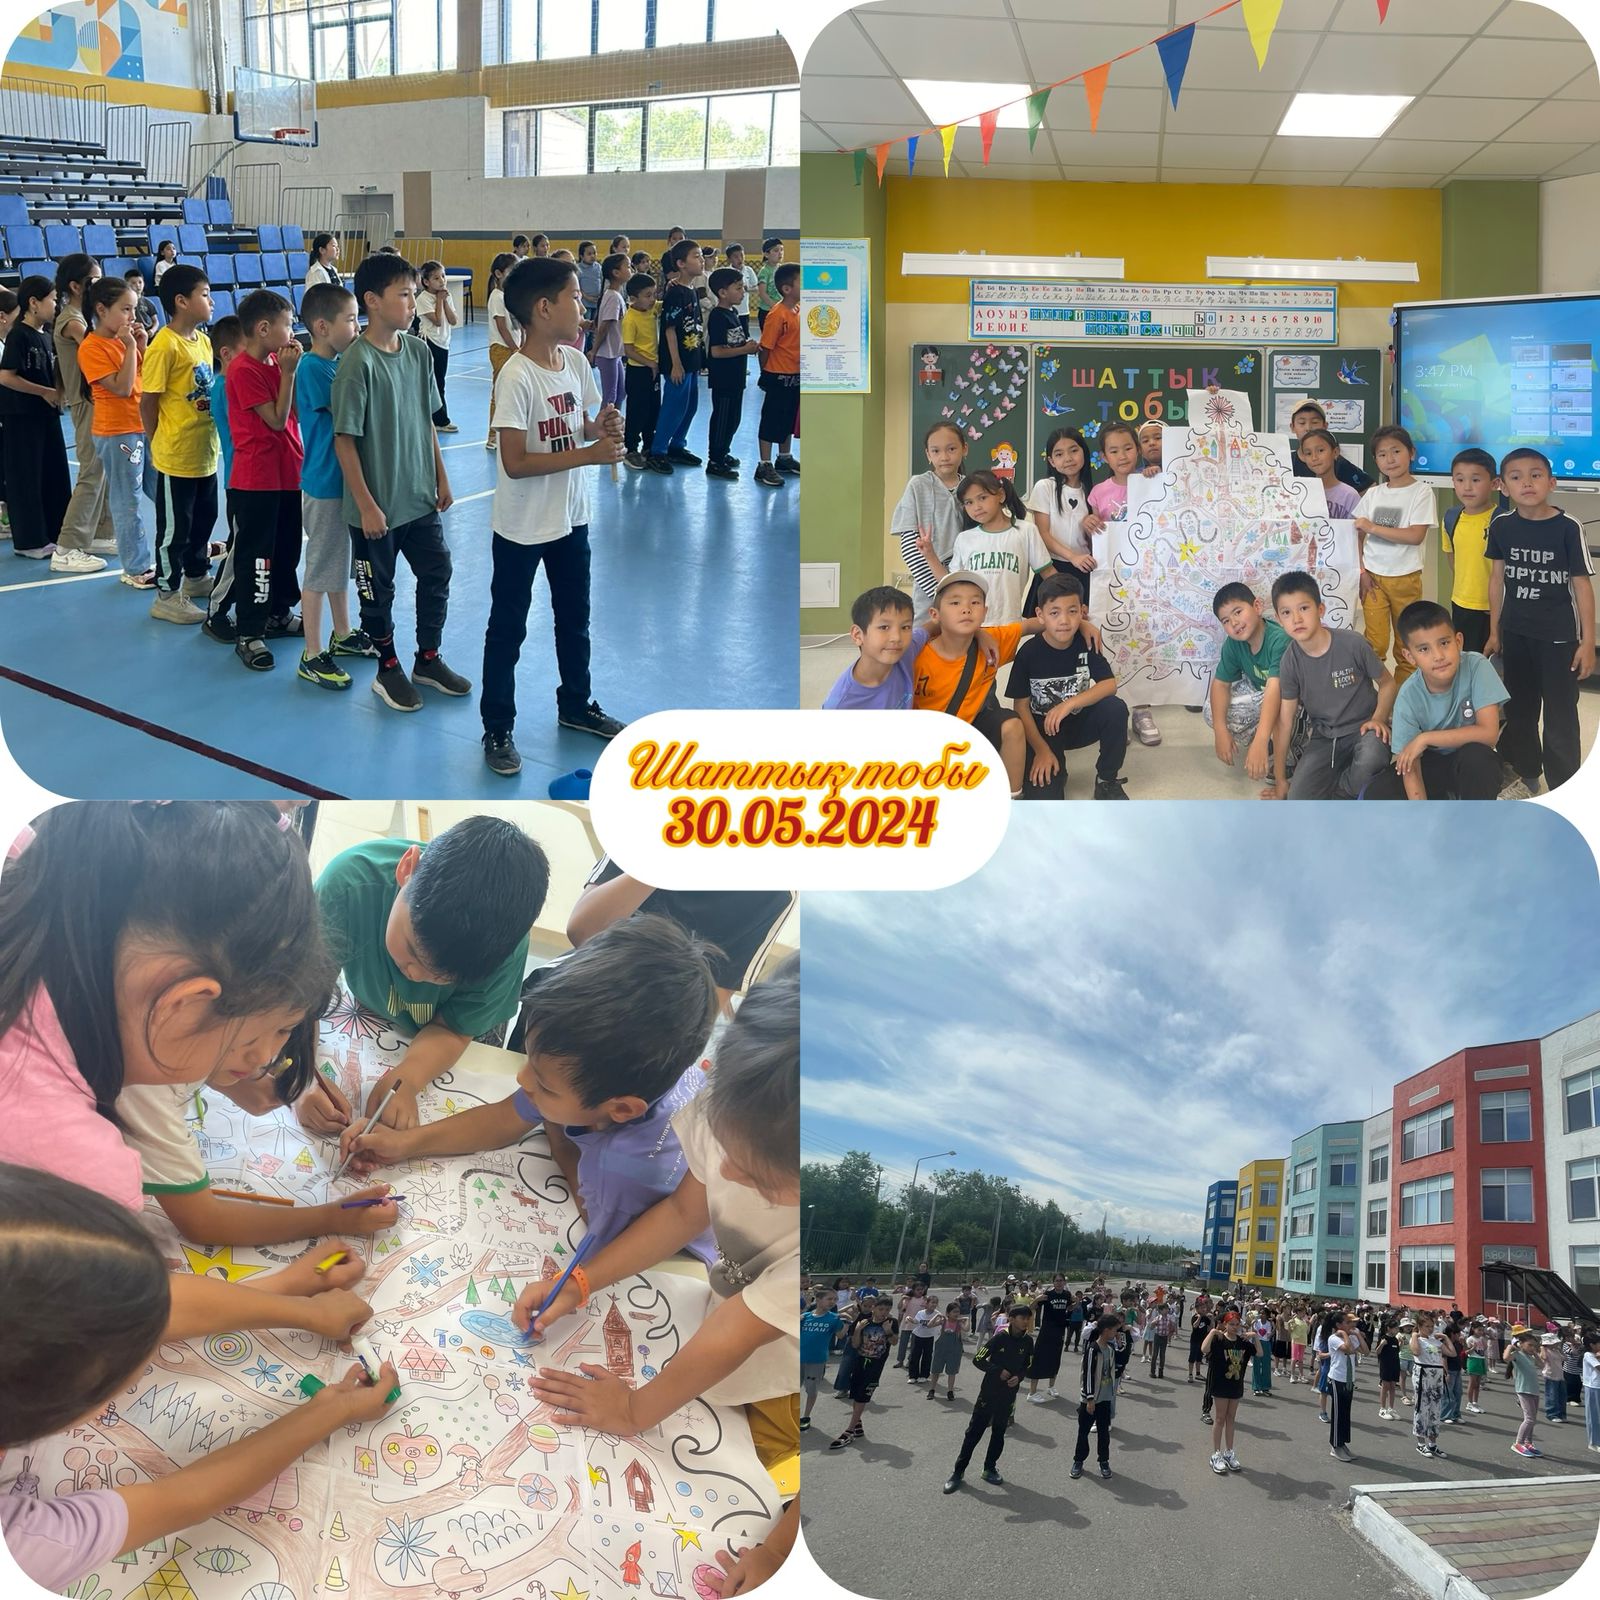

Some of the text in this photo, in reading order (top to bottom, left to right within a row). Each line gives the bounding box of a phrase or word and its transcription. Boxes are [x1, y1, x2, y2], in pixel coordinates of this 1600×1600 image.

[1415, 364, 1473, 378] 3:47 PM
[1510, 547, 1554, 564] STOP
[1505, 565, 1569, 584] OPYIN
[1516, 585, 1541, 600] ME
